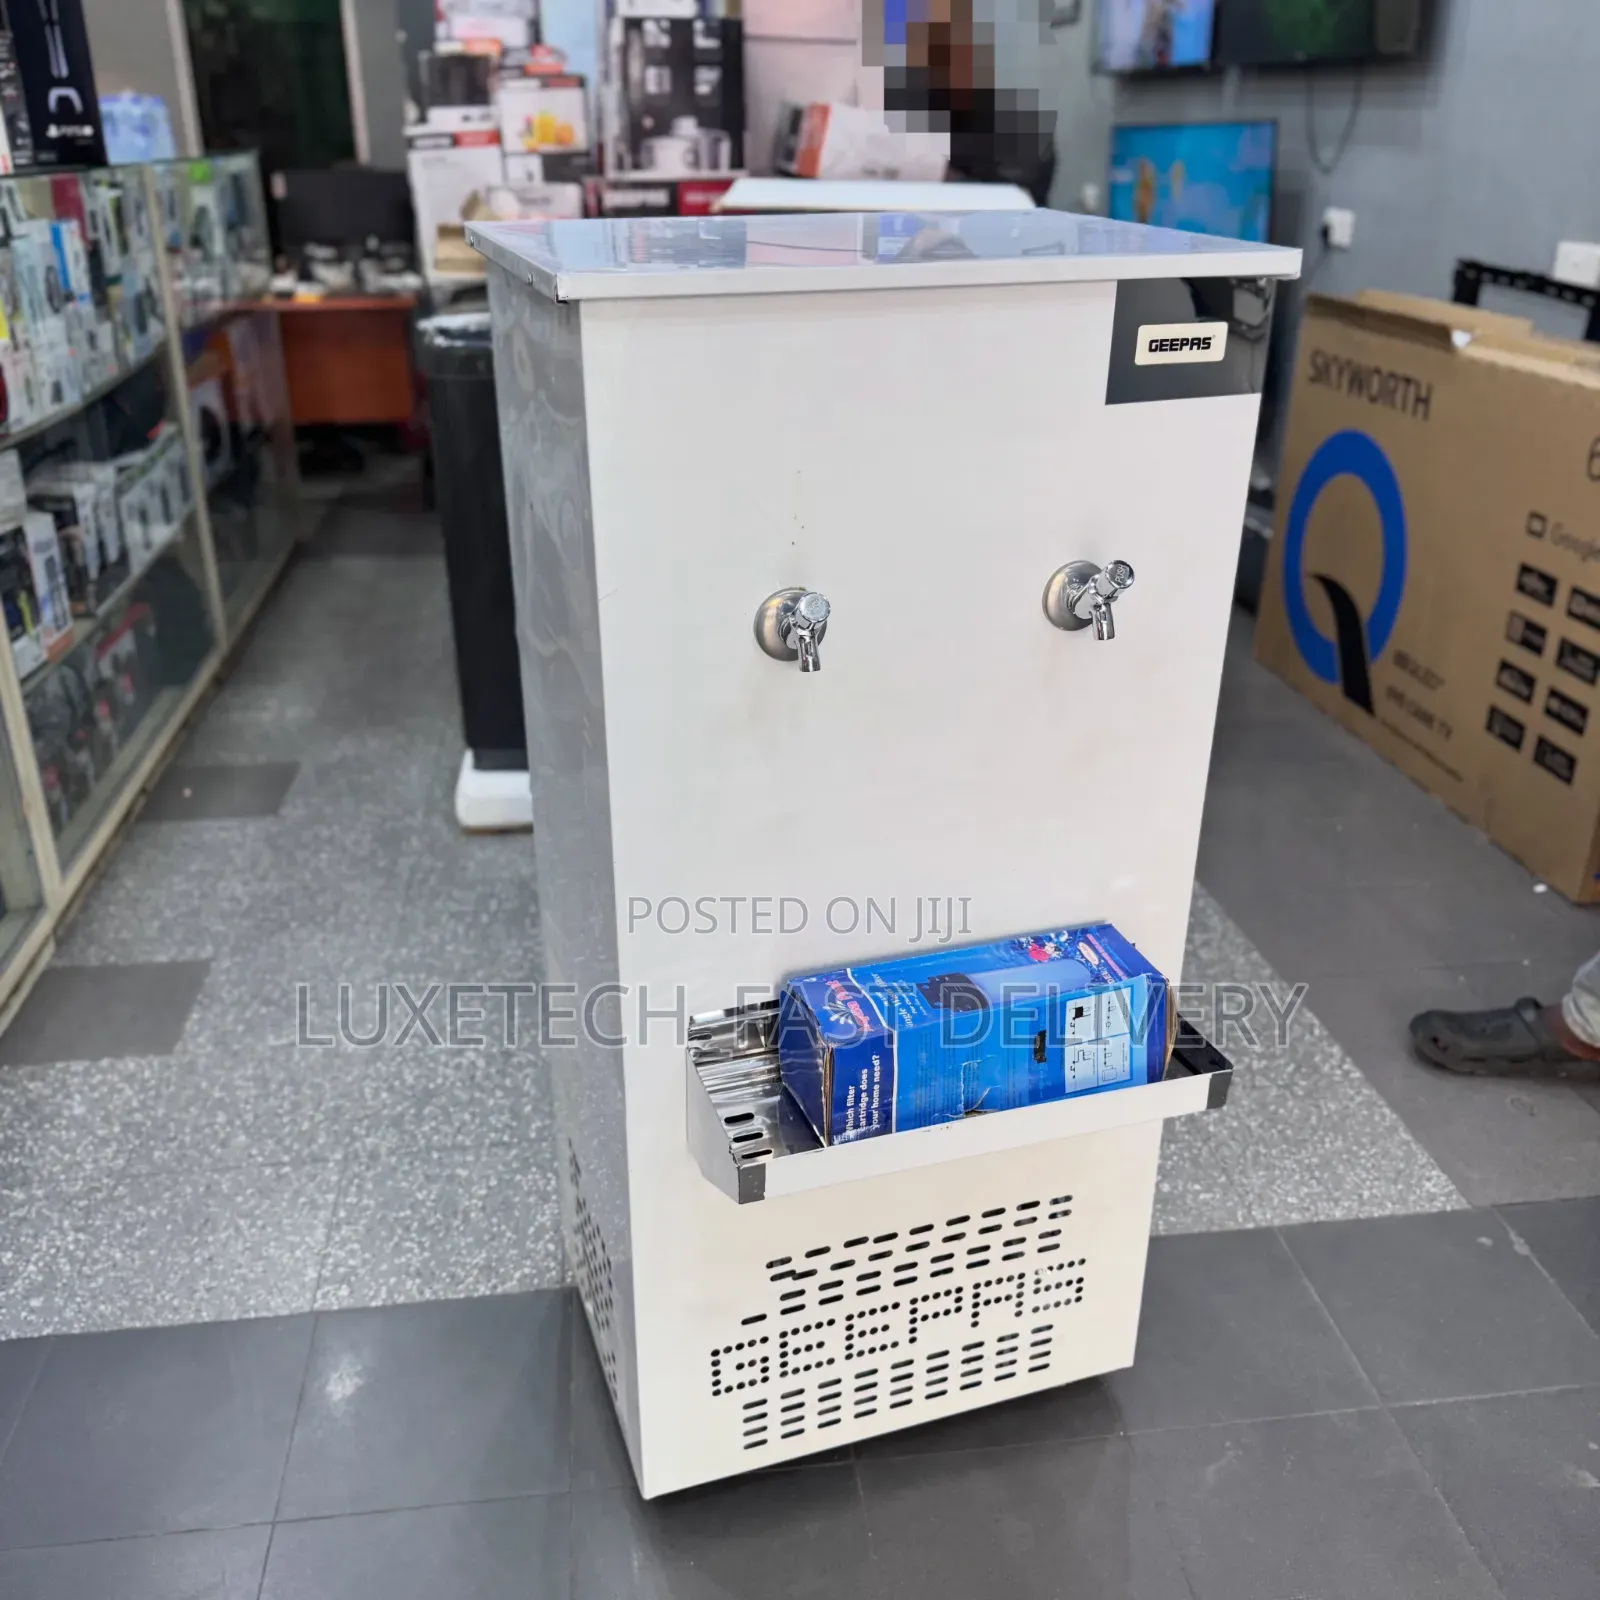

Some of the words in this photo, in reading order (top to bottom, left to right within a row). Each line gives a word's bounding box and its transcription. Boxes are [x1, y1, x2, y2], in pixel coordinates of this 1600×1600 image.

[1148, 336, 1212, 352] GEEPAS
[1308, 349, 1433, 421] SKYWORTH
[860, 1068, 868, 1091] does
[872, 1055, 880, 1082] need?
[847, 1085, 855, 1107] filter
[871, 1084, 880, 1109] home
[872, 1109, 880, 1130] your
[710, 1258, 1087, 1397] GEEPAS
